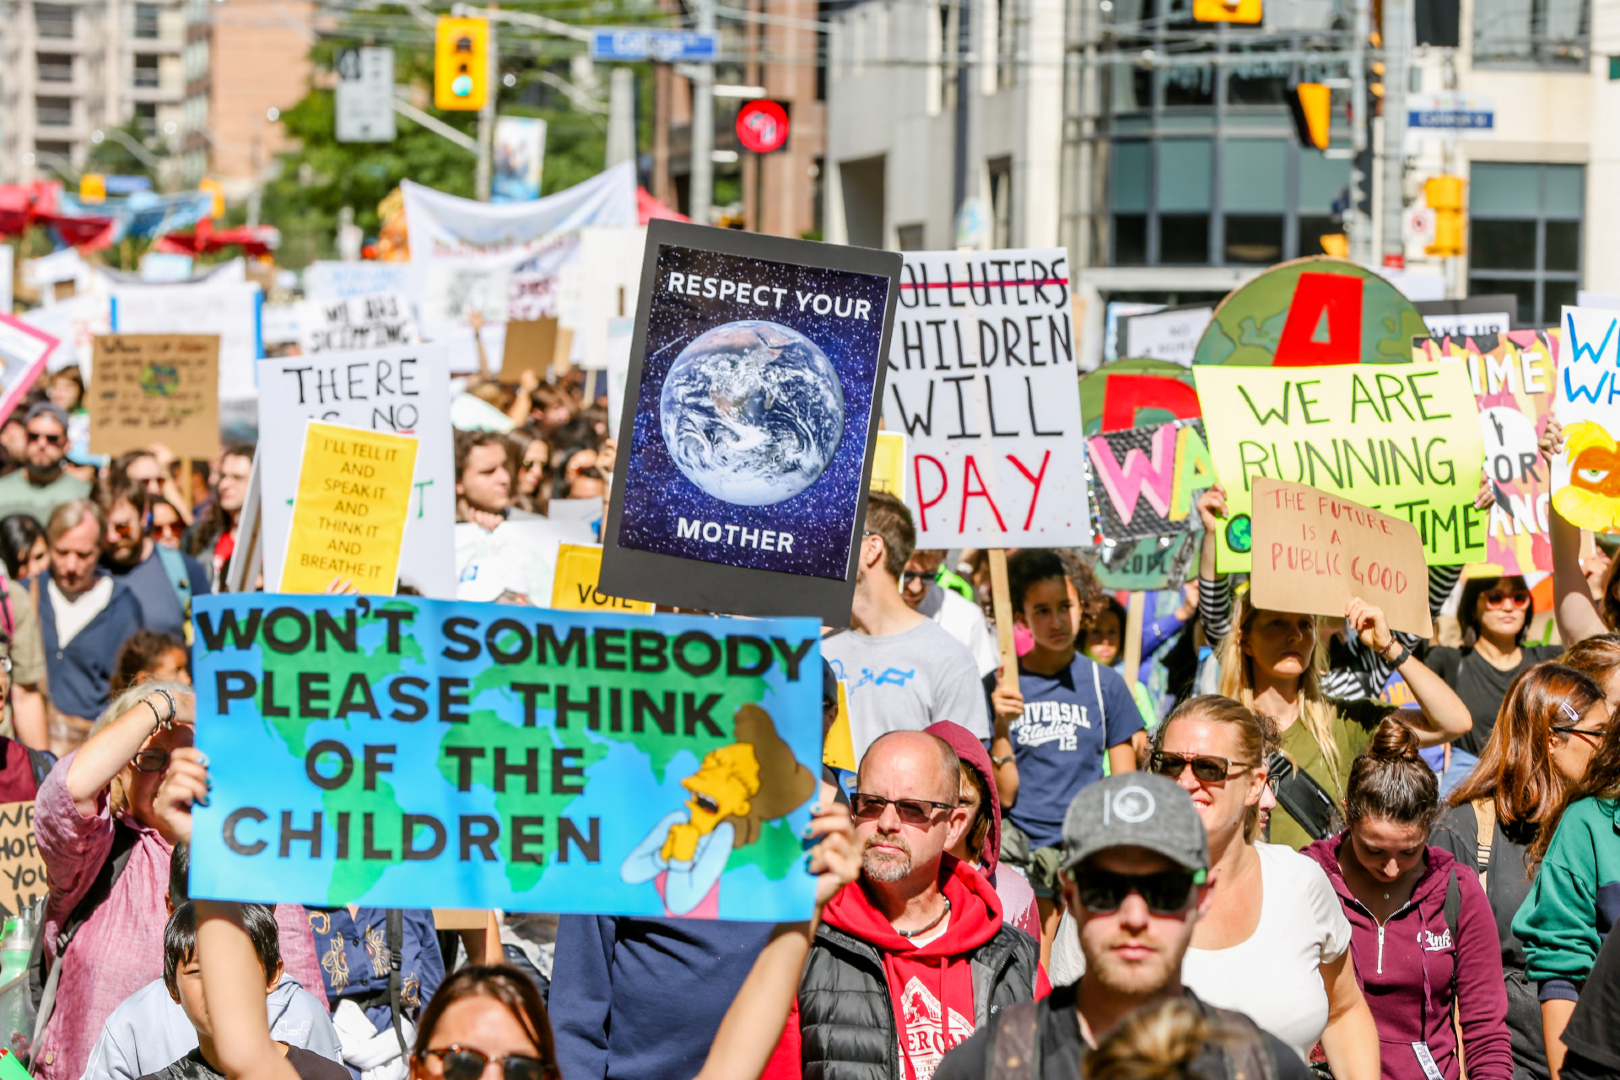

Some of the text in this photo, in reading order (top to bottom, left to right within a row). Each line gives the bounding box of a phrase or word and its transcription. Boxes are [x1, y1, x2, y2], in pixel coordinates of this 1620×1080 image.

[667, 271, 872, 321] RESPECT YOUR
[899, 257, 1068, 309] OLLUTERS
[888, 311, 1073, 371] HILDREN
[1567, 312, 1620, 368] W
[282, 358, 420, 404] THERE
[1440, 351, 1547, 395] IME
[372, 403, 420, 430] NO
[891, 375, 1064, 440] WILL
[1237, 379, 1331, 426] WE
[1350, 371, 1453, 424] ARE
[324, 439, 398, 463] I'LL TELL IT
[340, 461, 375, 479] AND
[1238, 436, 1456, 492] RUNNING
[1485, 452, 1542, 484] OR
[323, 477, 387, 500] SPEAK IT
[334, 500, 369, 517] AND
[913, 449, 1052, 534] PAY
[1262, 487, 1394, 536] THE FUTURE
[318, 516, 380, 539] THINK IT
[327, 538, 362, 556] AND
[676, 516, 795, 554] MOTHER
[1302, 523, 1342, 546] IS A
[1395, 499, 1486, 555] TIME
[300, 552, 382, 579] BREATHE IT
[1271, 541, 1408, 594] PUBLIC GOOD
[195, 597, 816, 682] WON'T SOMEBODY
[215, 670, 726, 738] PLEASE THINK
[1058, 734, 1078, 751] 12
[305, 739, 585, 796] OF THE
[222, 806, 601, 866] CHILDREN
[1416, 928, 1452, 951] Pink
